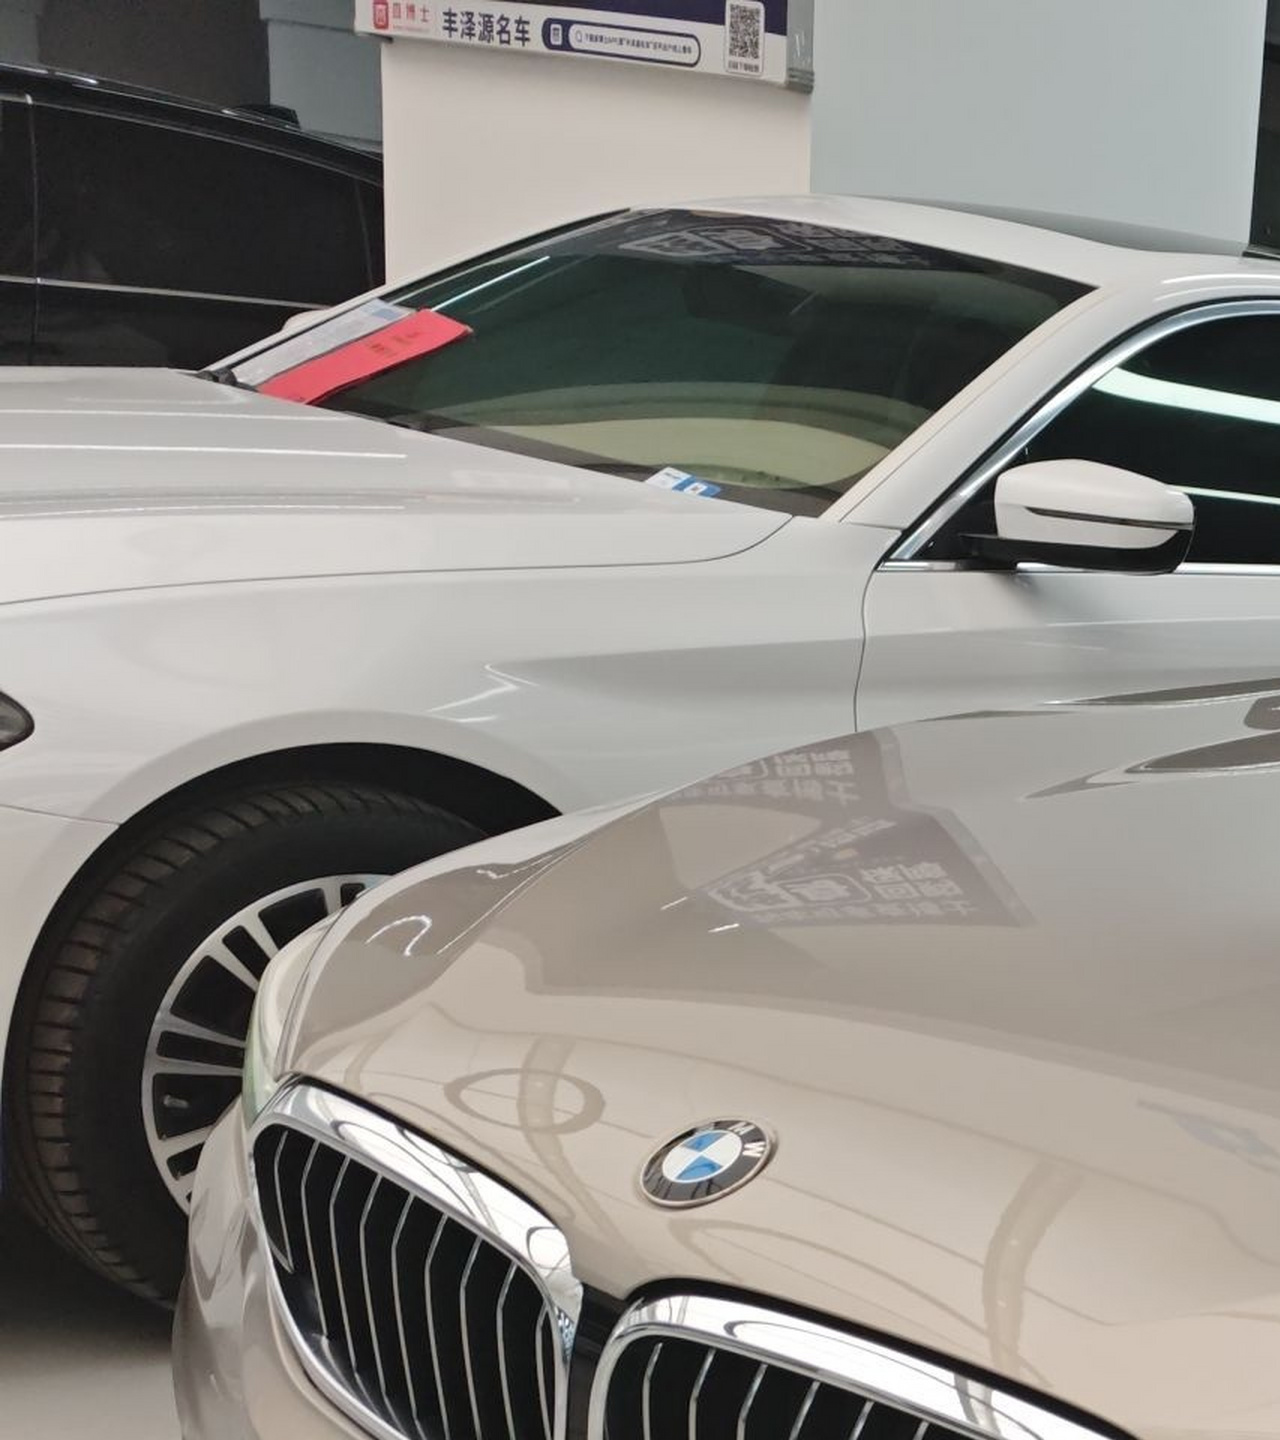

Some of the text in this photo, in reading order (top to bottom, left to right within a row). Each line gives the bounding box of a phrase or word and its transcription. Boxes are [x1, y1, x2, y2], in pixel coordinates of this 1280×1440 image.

[442, 8, 532, 47] 丰泽源名车
